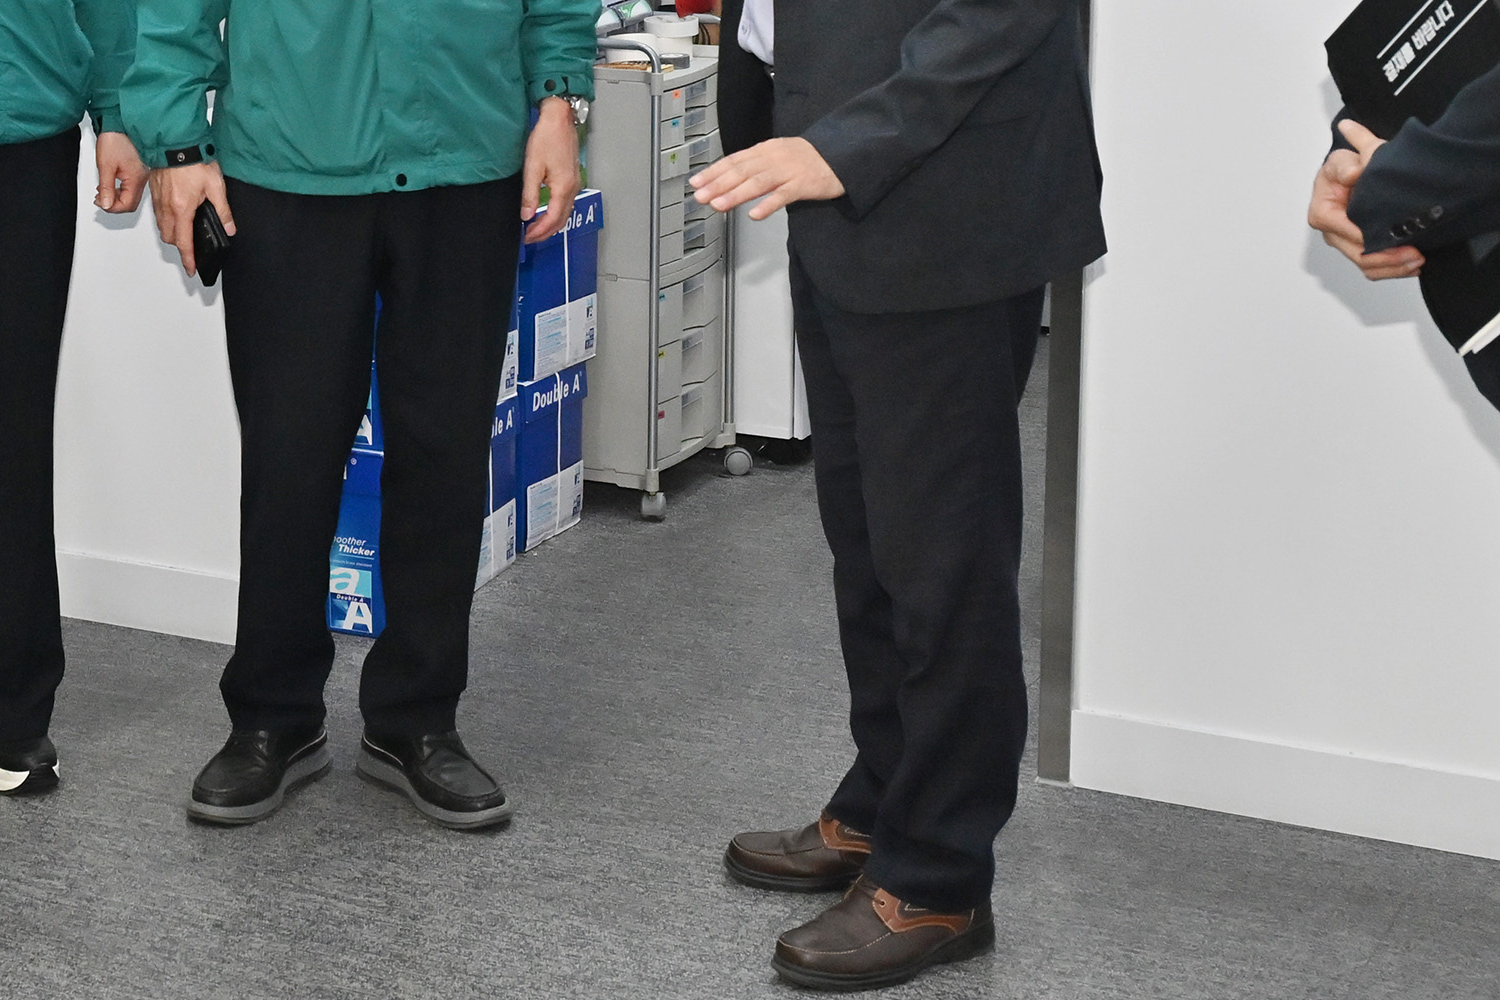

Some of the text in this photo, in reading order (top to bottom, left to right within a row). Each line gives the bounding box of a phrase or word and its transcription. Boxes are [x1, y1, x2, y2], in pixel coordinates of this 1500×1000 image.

[1410, 0, 1455, 50] 바랍니다
[585, 204, 594, 224] A
[532, 373, 580, 412] Double A
[334, 535, 366, 546] oother
[338, 544, 375, 556] Thicker
